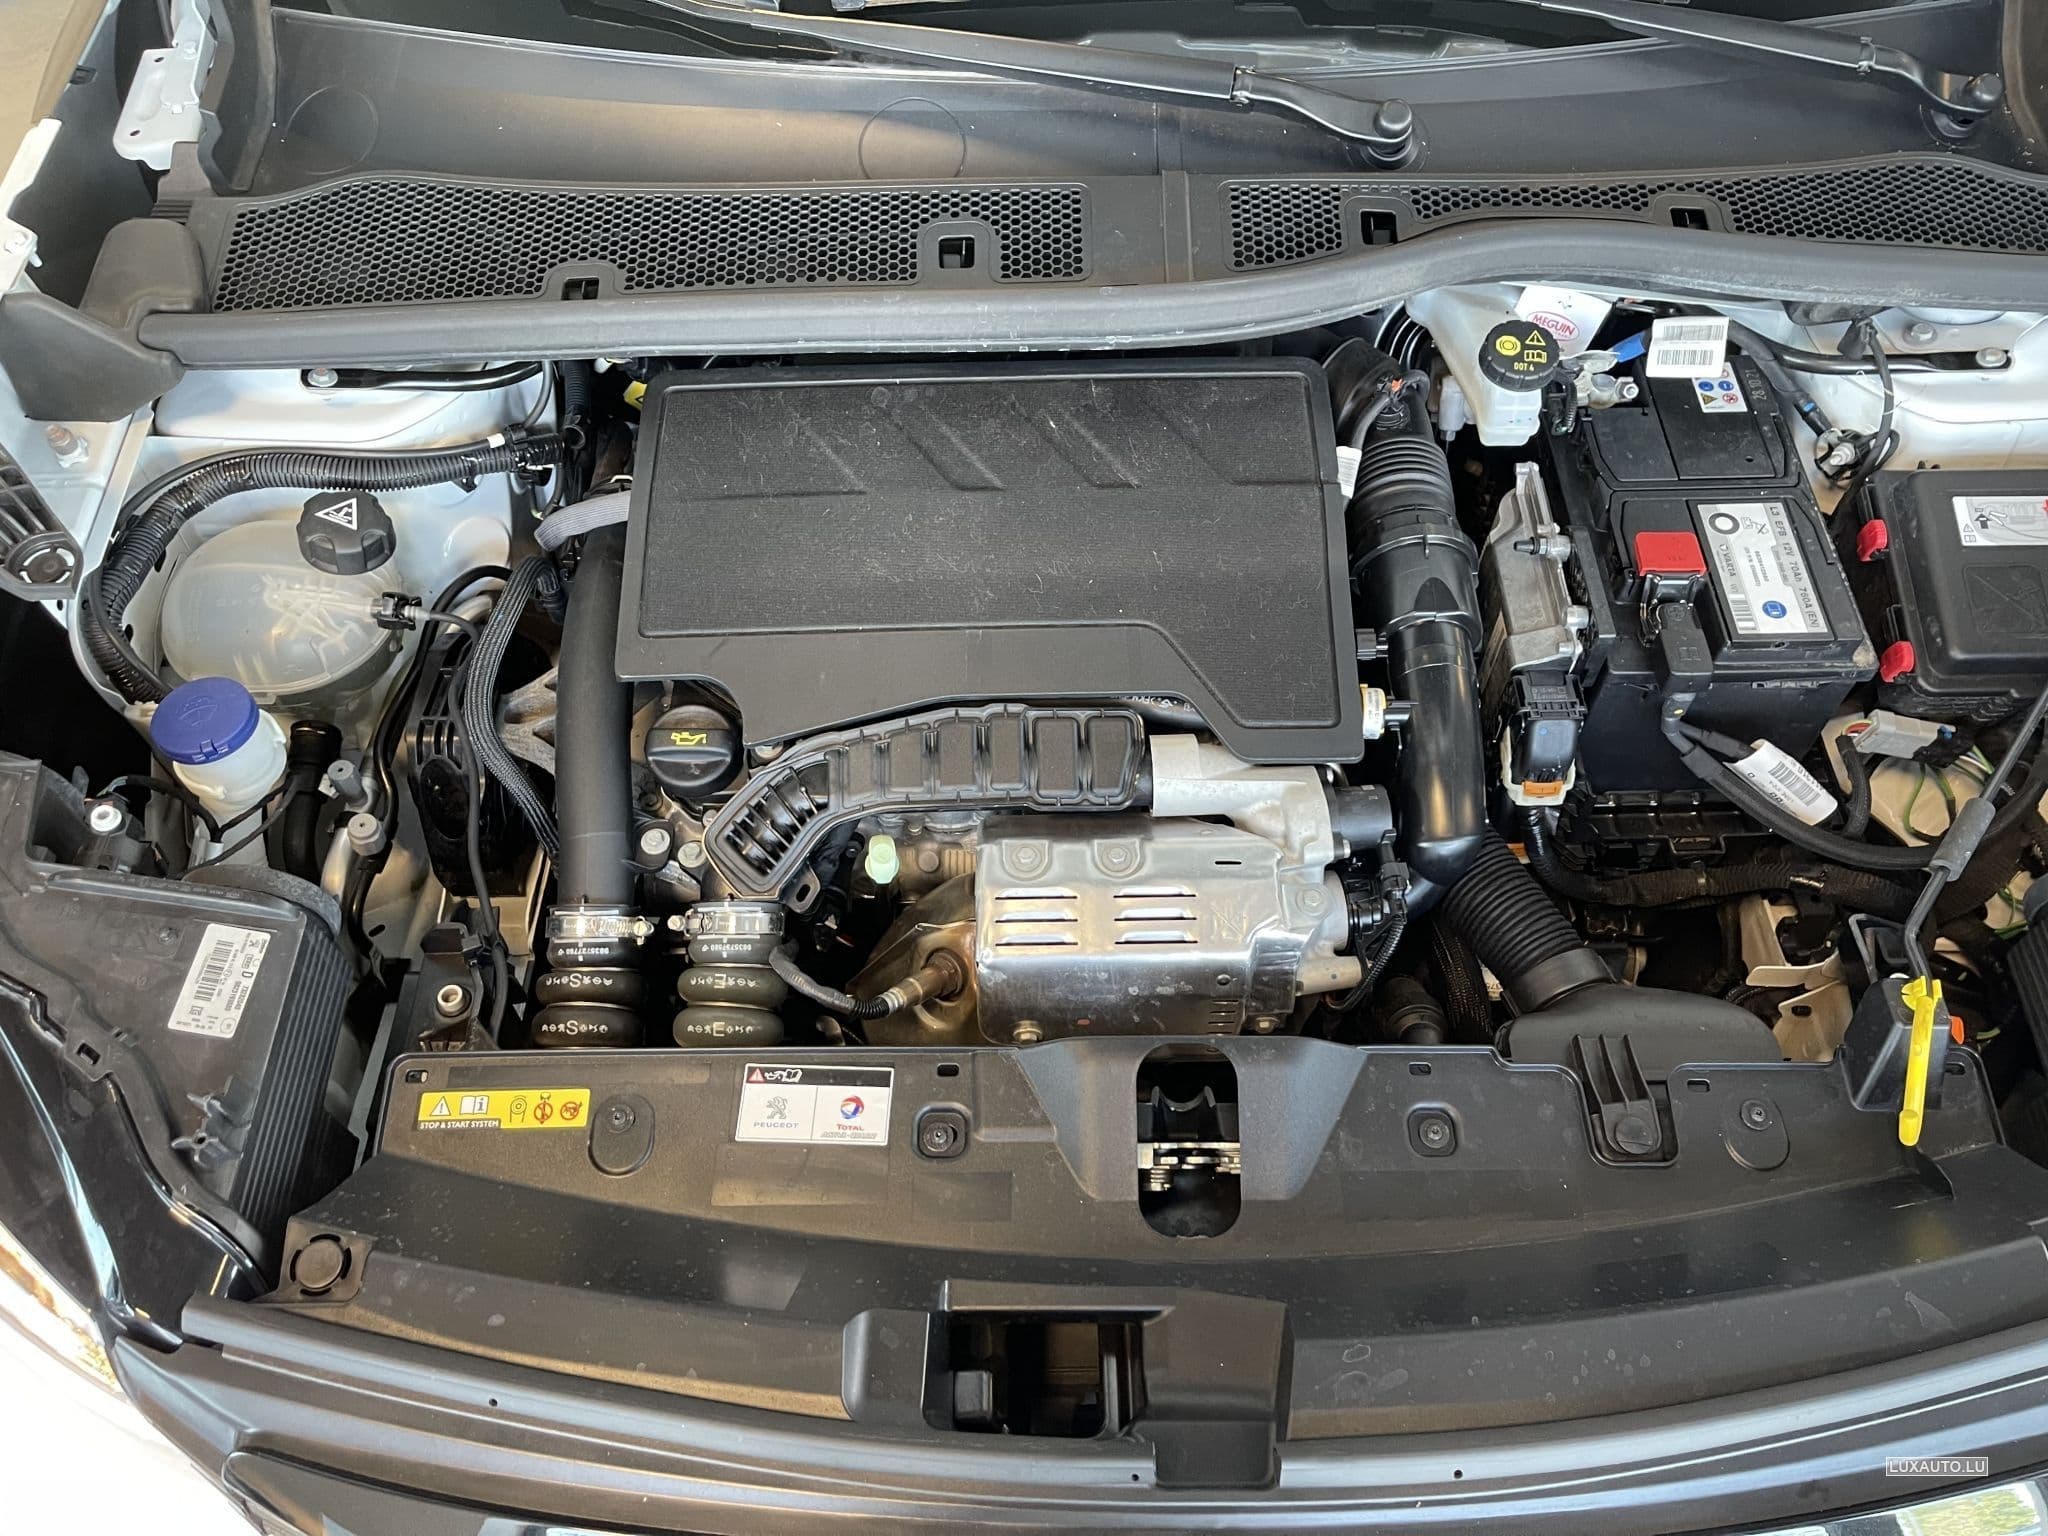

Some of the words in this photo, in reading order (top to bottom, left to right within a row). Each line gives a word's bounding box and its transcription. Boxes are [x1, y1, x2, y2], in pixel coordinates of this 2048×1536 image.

[1532, 314, 1576, 336] MEGUIN
[1513, 361, 1528, 371] DOT
[1529, 363, 1535, 372] 4
[1769, 506, 1780, 517] L3
[1775, 520, 1788, 537] EFB
[1783, 542, 1795, 557] 12V
[1791, 561, 1803, 582] 70Ah
[1799, 586, 1813, 609] 760A
[1724, 552, 1737, 577] VARTA
[420, 1121, 440, 1130] STOP
[440, 1121, 447, 1129] &
[447, 1120, 471, 1129] START
[471, 1119, 499, 1128] SYSTEM
[753, 1121, 800, 1129] PEUGEOT
[836, 1123, 865, 1131] TOTAL
